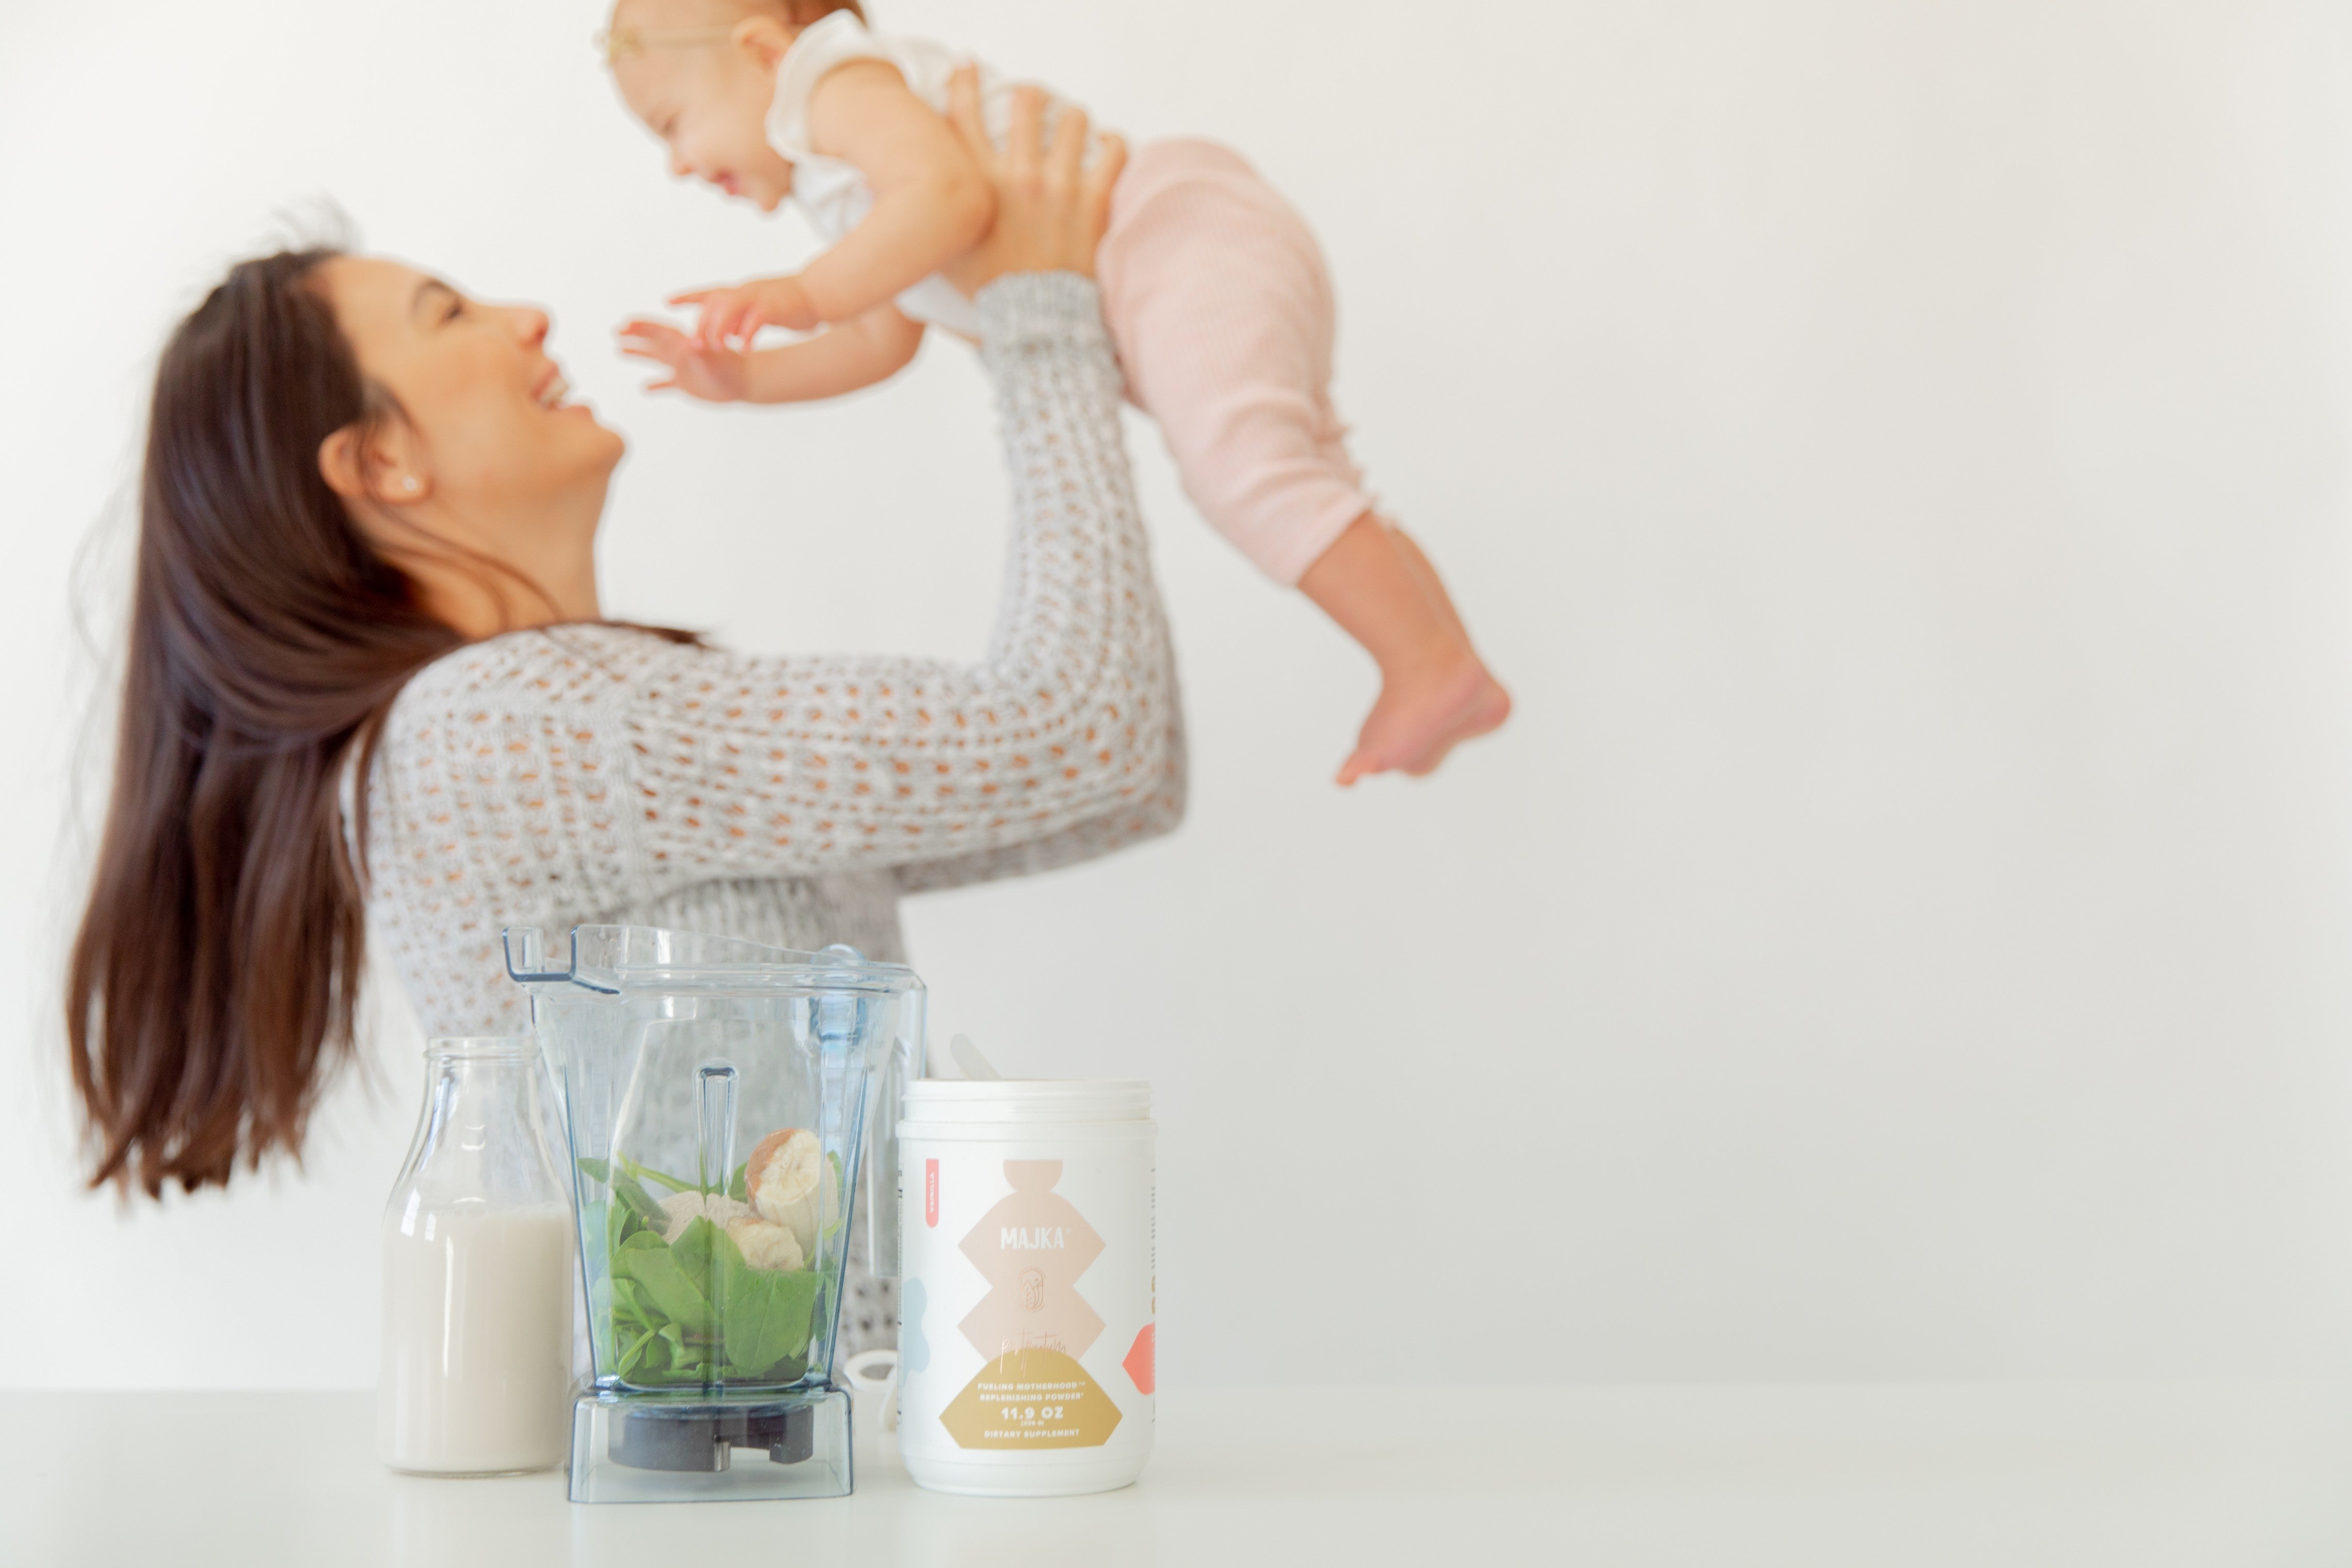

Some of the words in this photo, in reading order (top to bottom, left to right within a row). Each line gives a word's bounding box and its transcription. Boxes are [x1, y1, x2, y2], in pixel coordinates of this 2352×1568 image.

[980, 1393, 1043, 1402] REPLENISHING
[1001, 1406, 1035, 1420] 11.9
[1041, 1406, 1064, 1420] OZ
[984, 1430, 1021, 1438] DIETARY
[1024, 1429, 1080, 1438] SUPPLEMENT
